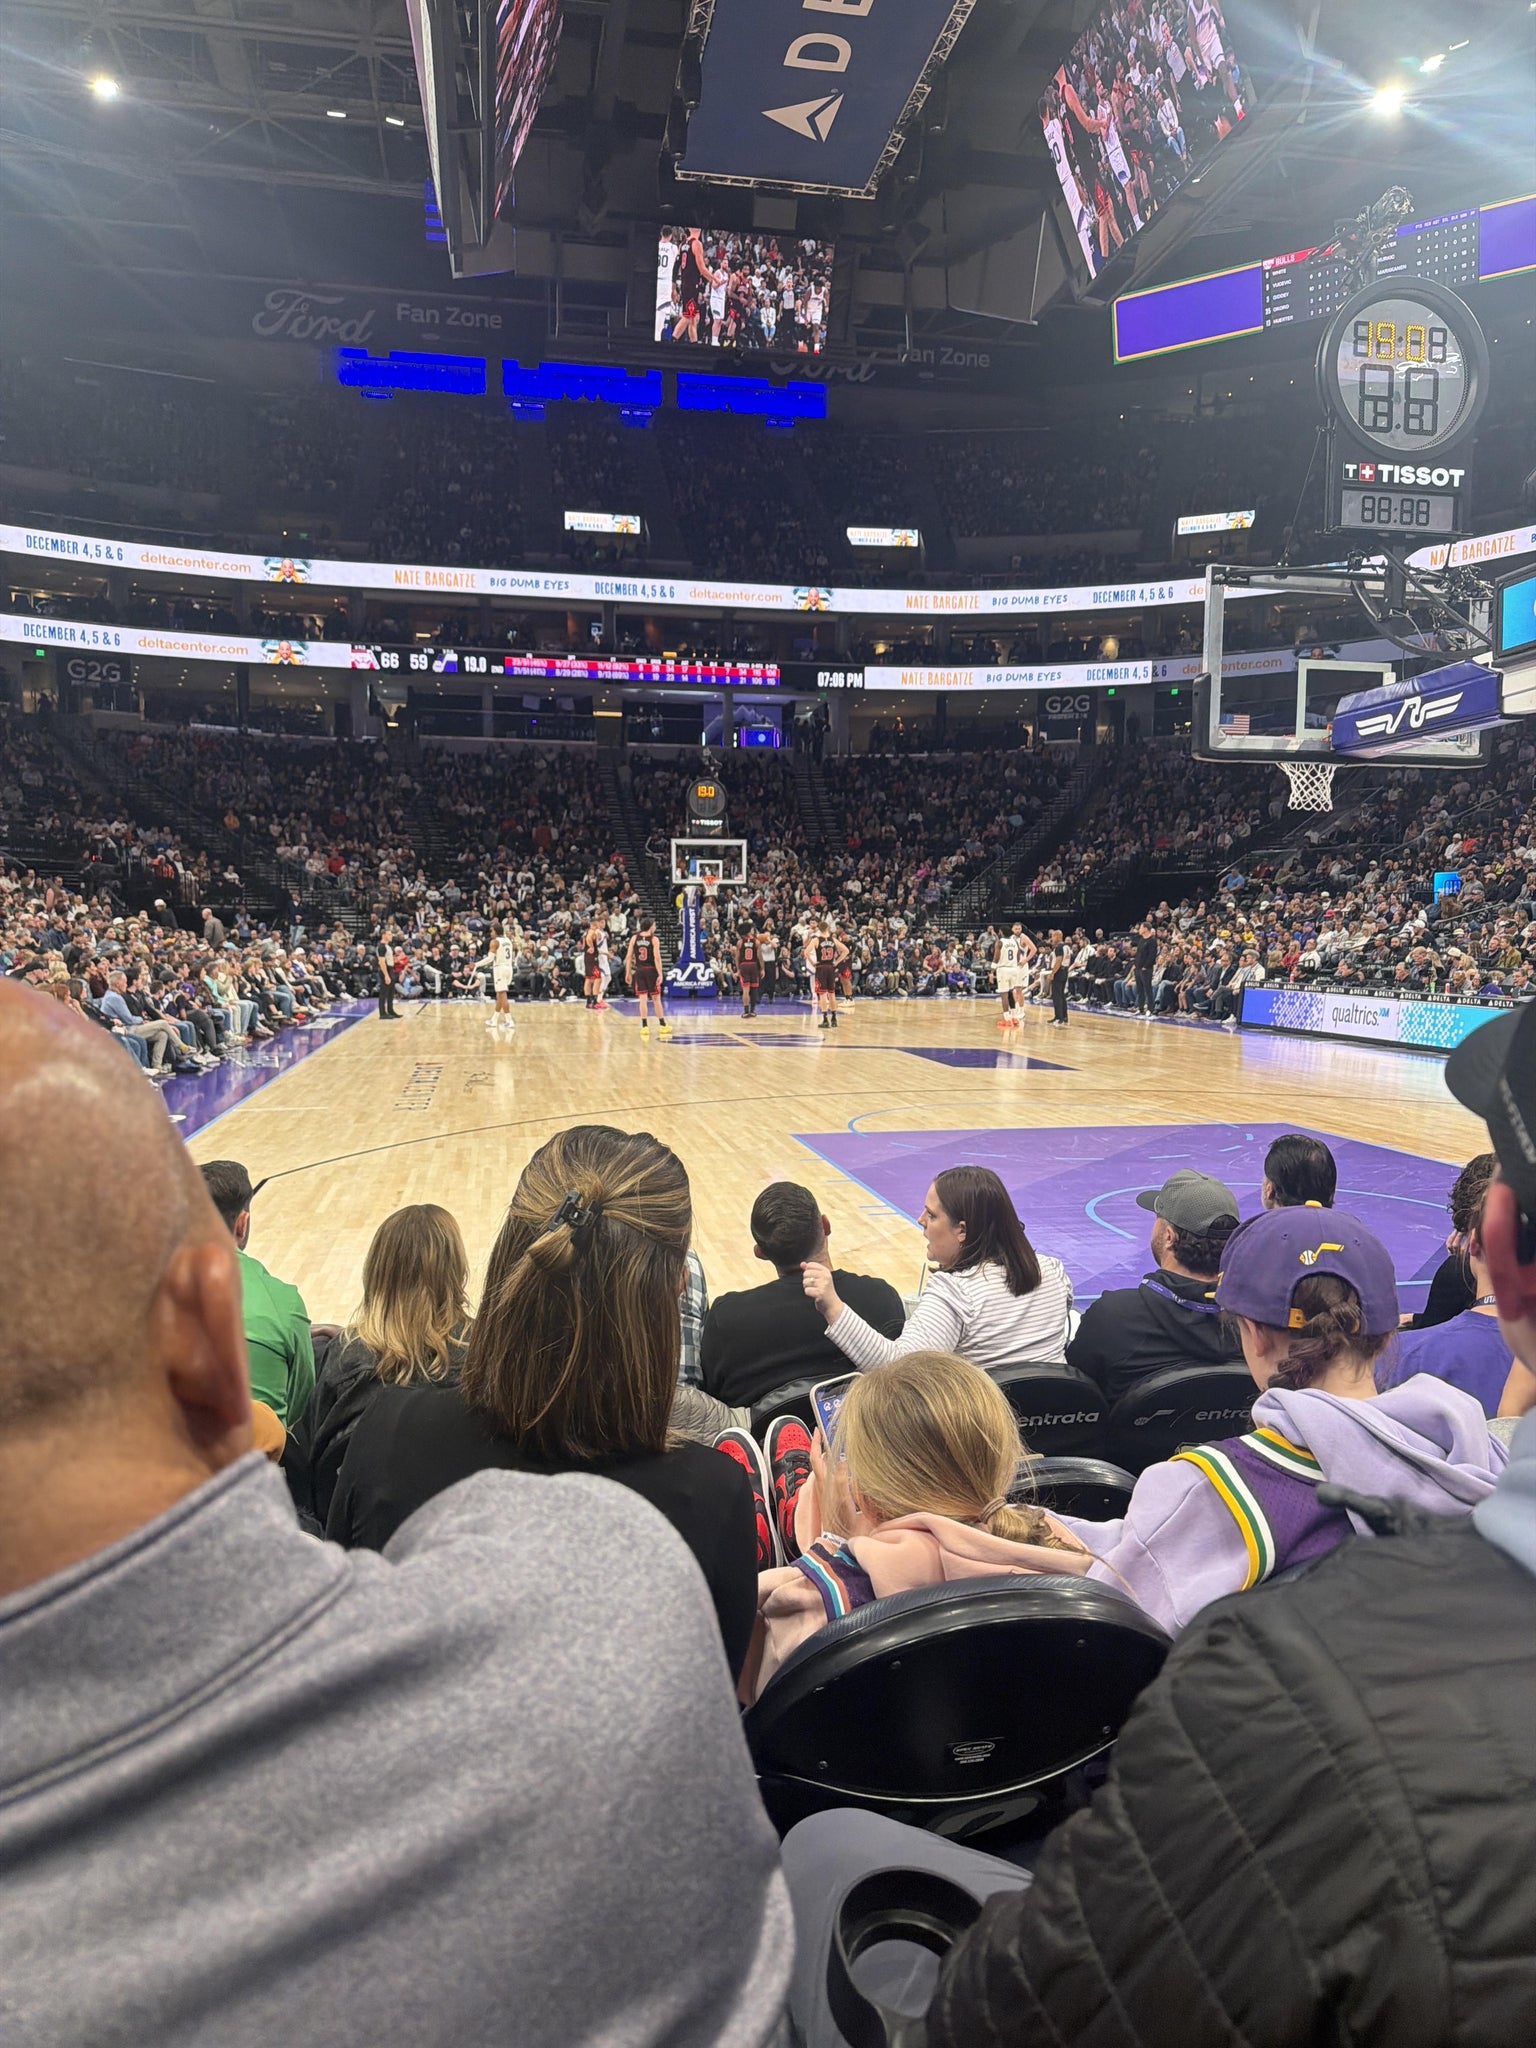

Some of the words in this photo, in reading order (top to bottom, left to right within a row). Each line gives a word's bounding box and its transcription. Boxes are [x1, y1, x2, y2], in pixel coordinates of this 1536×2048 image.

[252, 289, 374, 343] Ford
[396, 302, 440, 324] Fan
[445, 306, 502, 330] Zone
[940, 348, 990, 368] Zone
[1378, 464, 1465, 488] TISSOT
[25, 534, 79, 555] DECEMBER
[117, 547, 124, 561] 6
[140, 551, 251, 574] deltacenter.com
[1462, 534, 1515, 563] BARGATZE
[394, 569, 420, 586] NATE
[424, 571, 476, 589] BARGATZE
[490, 577, 507, 587] BIG
[510, 578, 540, 589] DUMB
[543, 580, 570, 590] EYES
[595, 581, 638, 597] DECEMBER
[669, 586, 675, 598] 6
[689, 587, 783, 603] deltacenter.com
[906, 595, 929, 609] NATE
[933, 595, 979, 610] BARGATZE
[992, 597, 1008, 606] BIG
[1012, 595, 1040, 605] DUMB
[1043, 594, 1068, 605] EYES
[1093, 588, 1136, 604] DECEMBER
[1168, 586, 1174, 599] 6
[23, 623, 76, 643] DECEMBER
[114, 633, 121, 646] 6
[138, 636, 248, 655] deltacenter.com
[67, 659, 121, 683] G2G
[380, 652, 400, 669] 66
[409, 653, 429, 670] 59
[464, 656, 487, 673] 19.0
[817, 671, 845, 688] 07:06
[846, 672, 863, 688] PM
[901, 672, 924, 686] NATE
[928, 672, 973, 686] BARGATZE
[986, 673, 1002, 683] BIG
[1005, 672, 1033, 682] DUMB
[1037, 671, 1062, 682] EYES
[1086, 667, 1130, 681] DECEMBER
[1161, 665, 1167, 676] 6
[1045, 694, 1090, 713] G2G
[1007, 949, 1014, 961] 8
